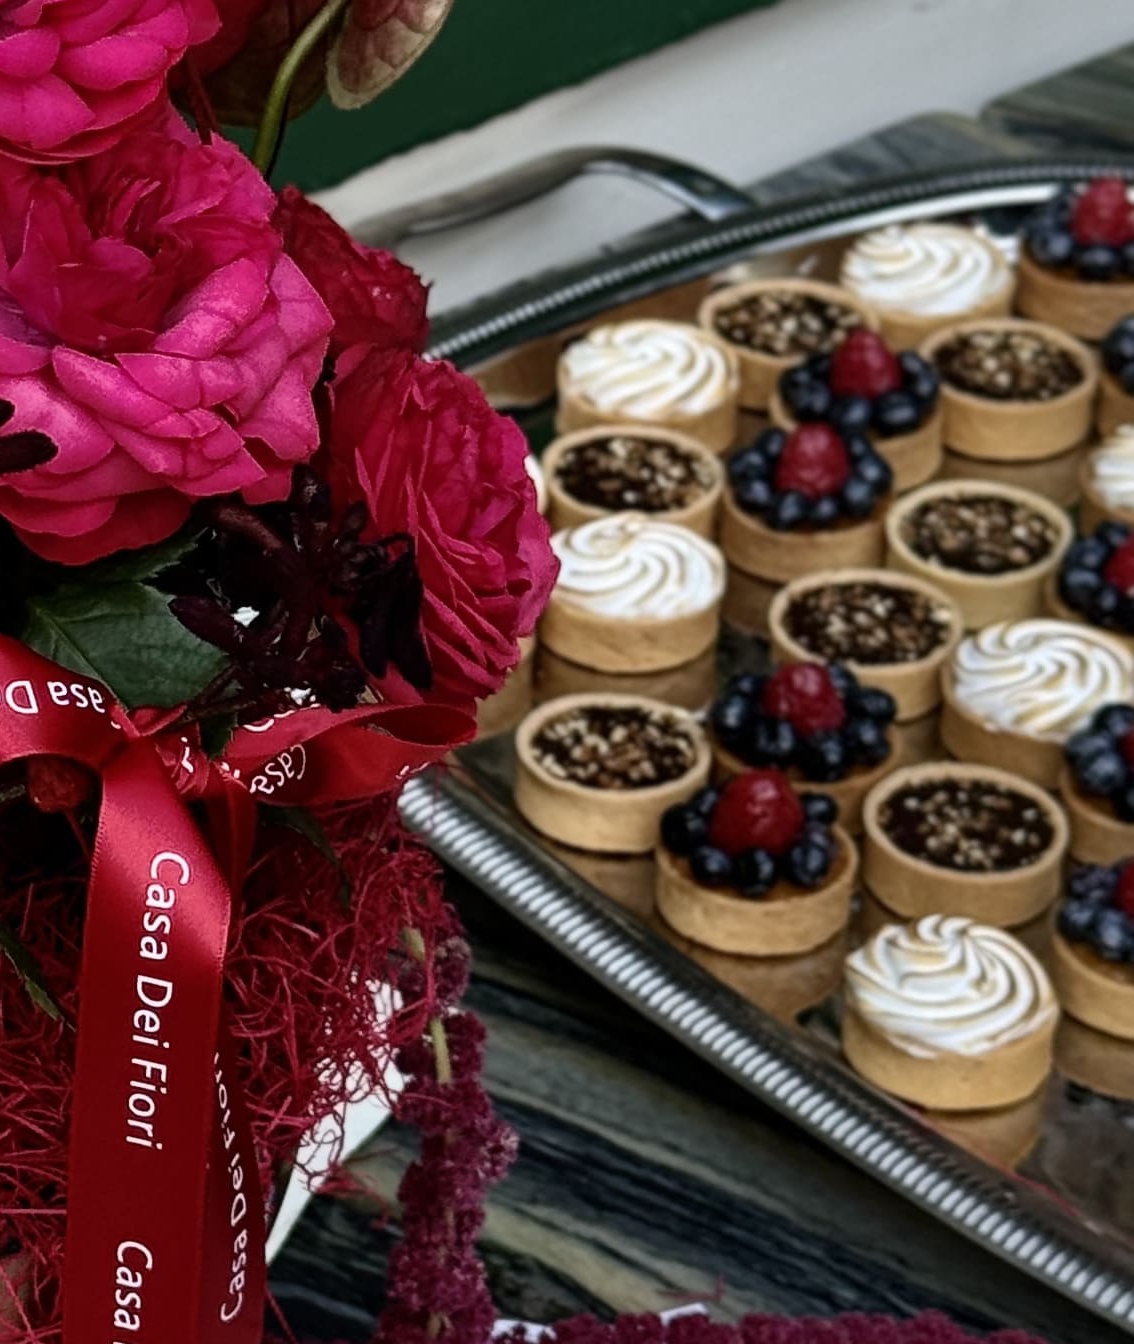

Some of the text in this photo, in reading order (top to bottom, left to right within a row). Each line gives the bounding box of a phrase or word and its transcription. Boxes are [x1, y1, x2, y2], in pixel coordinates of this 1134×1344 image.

[46, 681, 121, 730] asa
[250, 743, 307, 795] Casa
[126, 851, 190, 1150] Casa Dei Fiori
[228, 1153, 247, 1227] Dei
[113, 1241, 153, 1331] Casa
[220, 1229, 248, 1323] Casa
